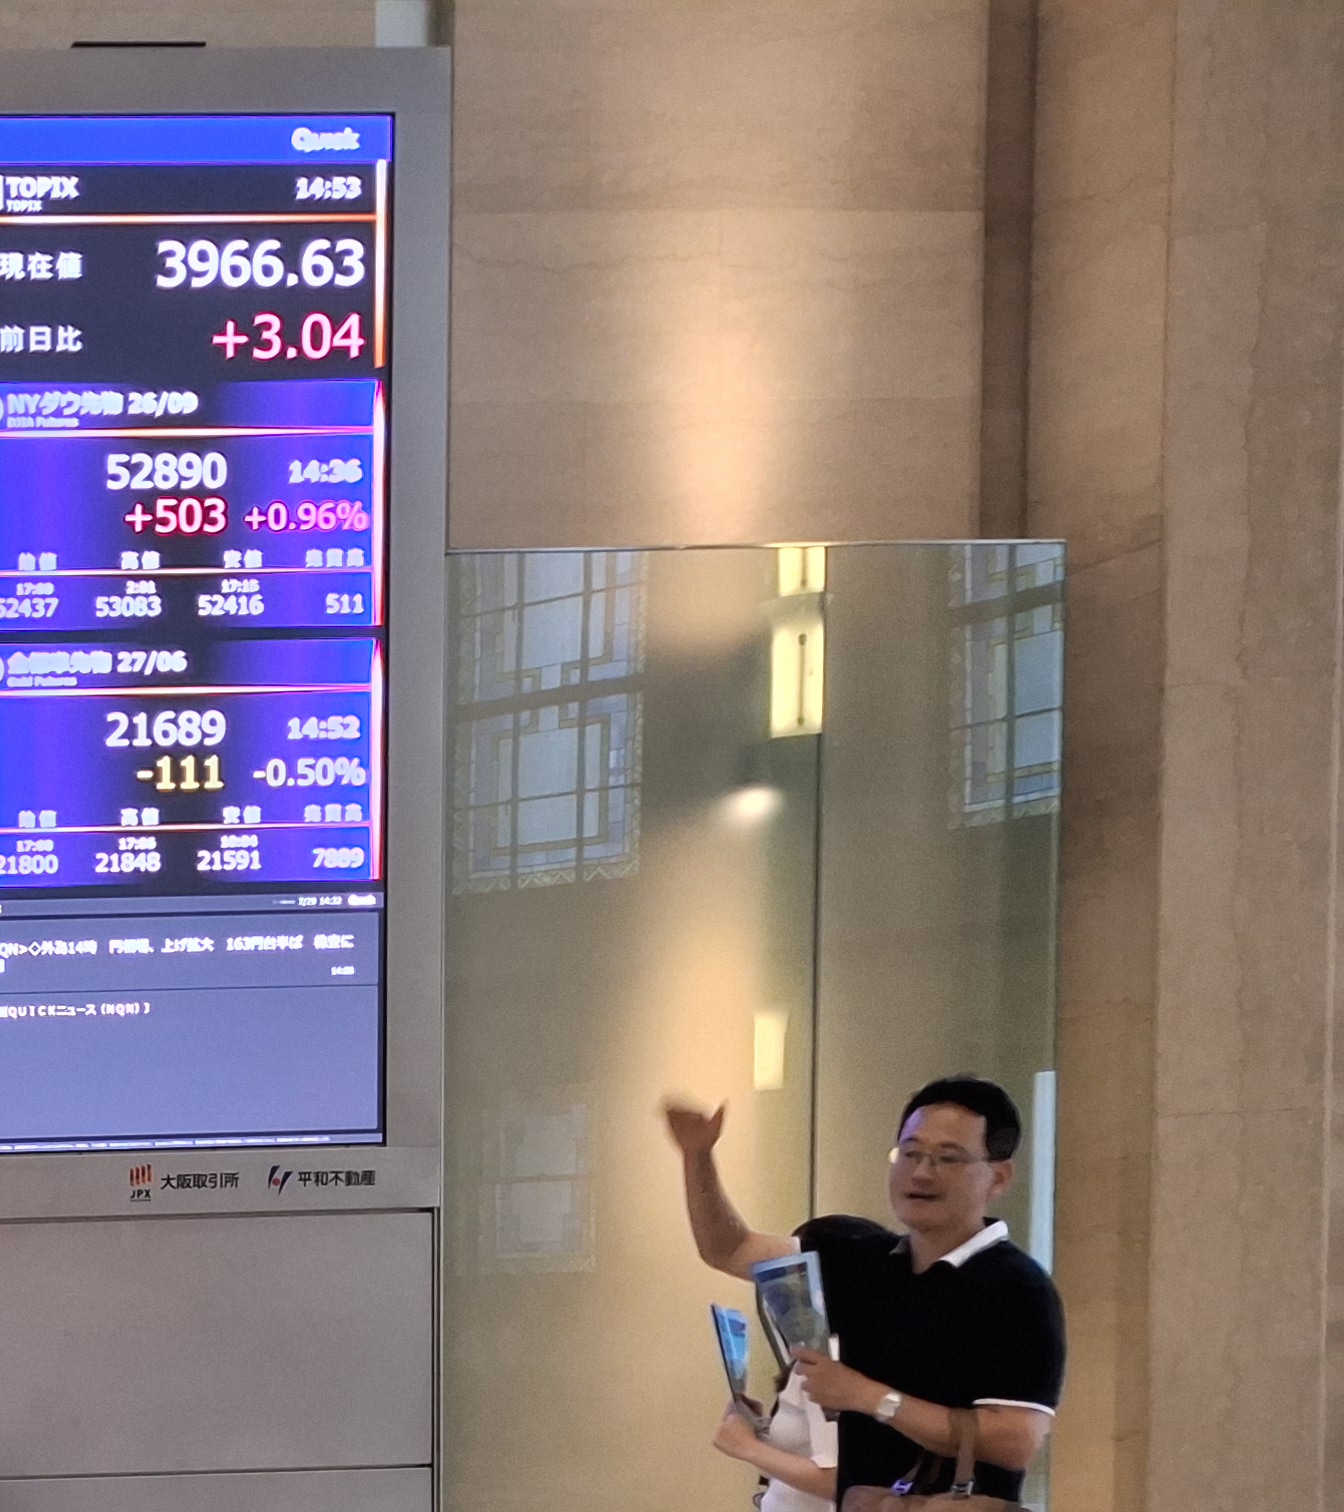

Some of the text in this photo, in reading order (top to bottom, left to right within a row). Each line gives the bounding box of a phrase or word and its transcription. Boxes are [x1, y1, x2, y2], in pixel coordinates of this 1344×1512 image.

[3, 176, 79, 201] TOPIX
[0, 239, 364, 288] 現在値 3966.63
[0, 314, 364, 359] 前日比 +3.04
[107, 452, 227, 490] 52890
[125, 498, 370, 533] +503 +0.96%
[96, 596, 161, 617] 53083
[198, 592, 264, 616] 52416
[326, 593, 364, 614] 511
[106, 710, 226, 747] 21689
[137, 755, 366, 789] -111 -0.50%
[95, 852, 161, 872] 21848
[197, 847, 261, 870] 21591
[160, 1172, 240, 1190] 大阪取引所
[297, 1170, 376, 1187] 平和不動産
[130, 1189, 152, 1200] JPX
